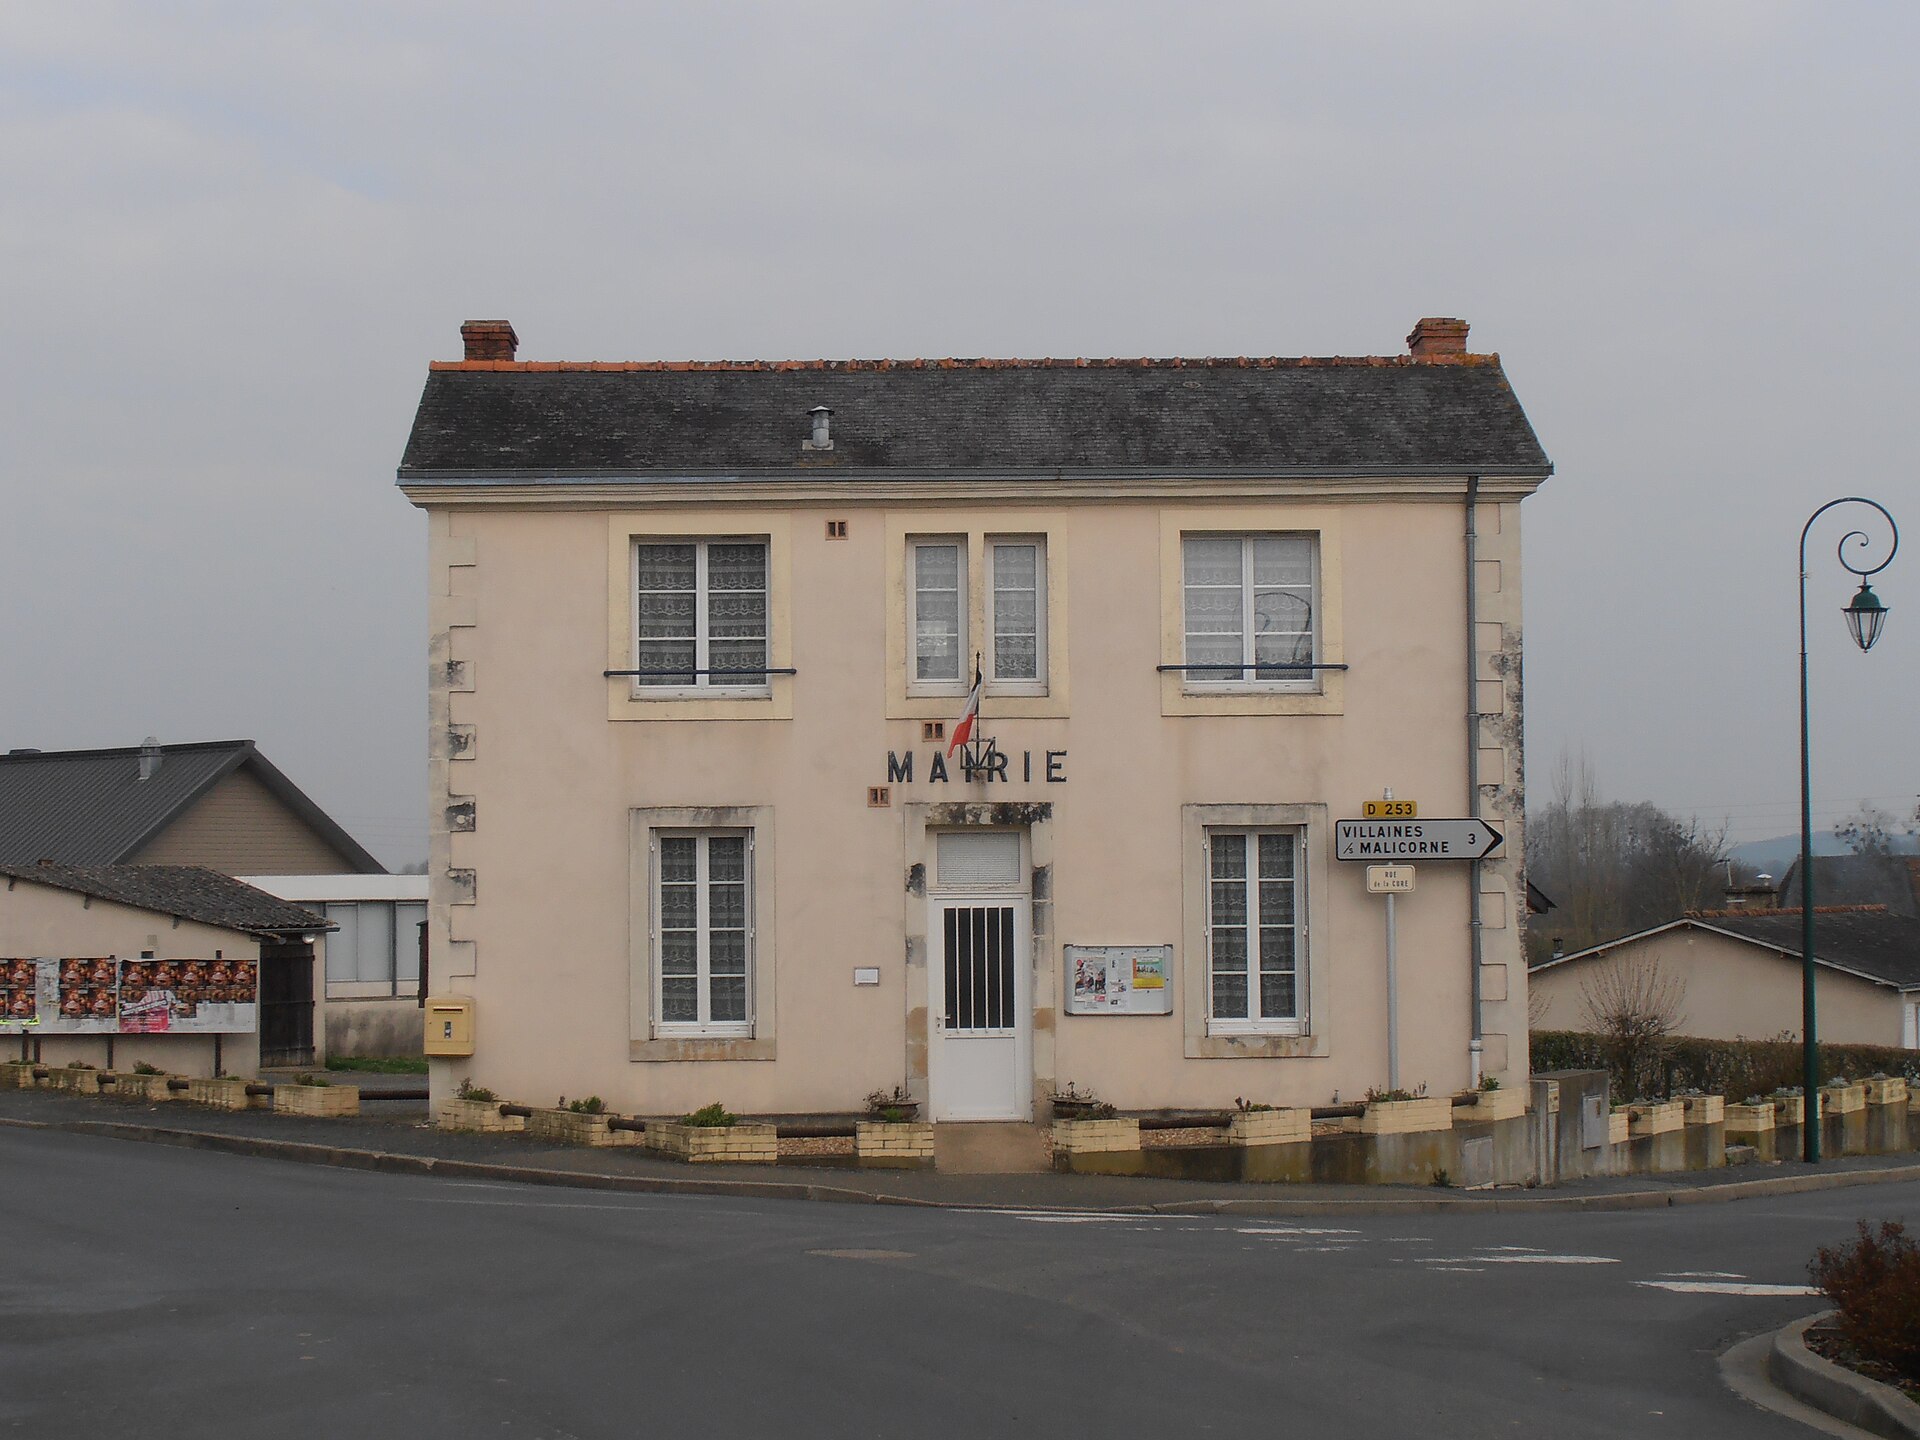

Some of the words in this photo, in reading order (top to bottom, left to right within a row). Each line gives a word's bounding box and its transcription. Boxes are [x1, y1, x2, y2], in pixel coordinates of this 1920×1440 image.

[888, 750, 1067, 782] MAIRIE
[1367, 803, 1376, 815] D
[1384, 803, 1412, 815] 253
[1343, 826, 1423, 838] VILLAINES
[1468, 833, 1476, 845] 3
[1360, 841, 1449, 854] MALICORNE
